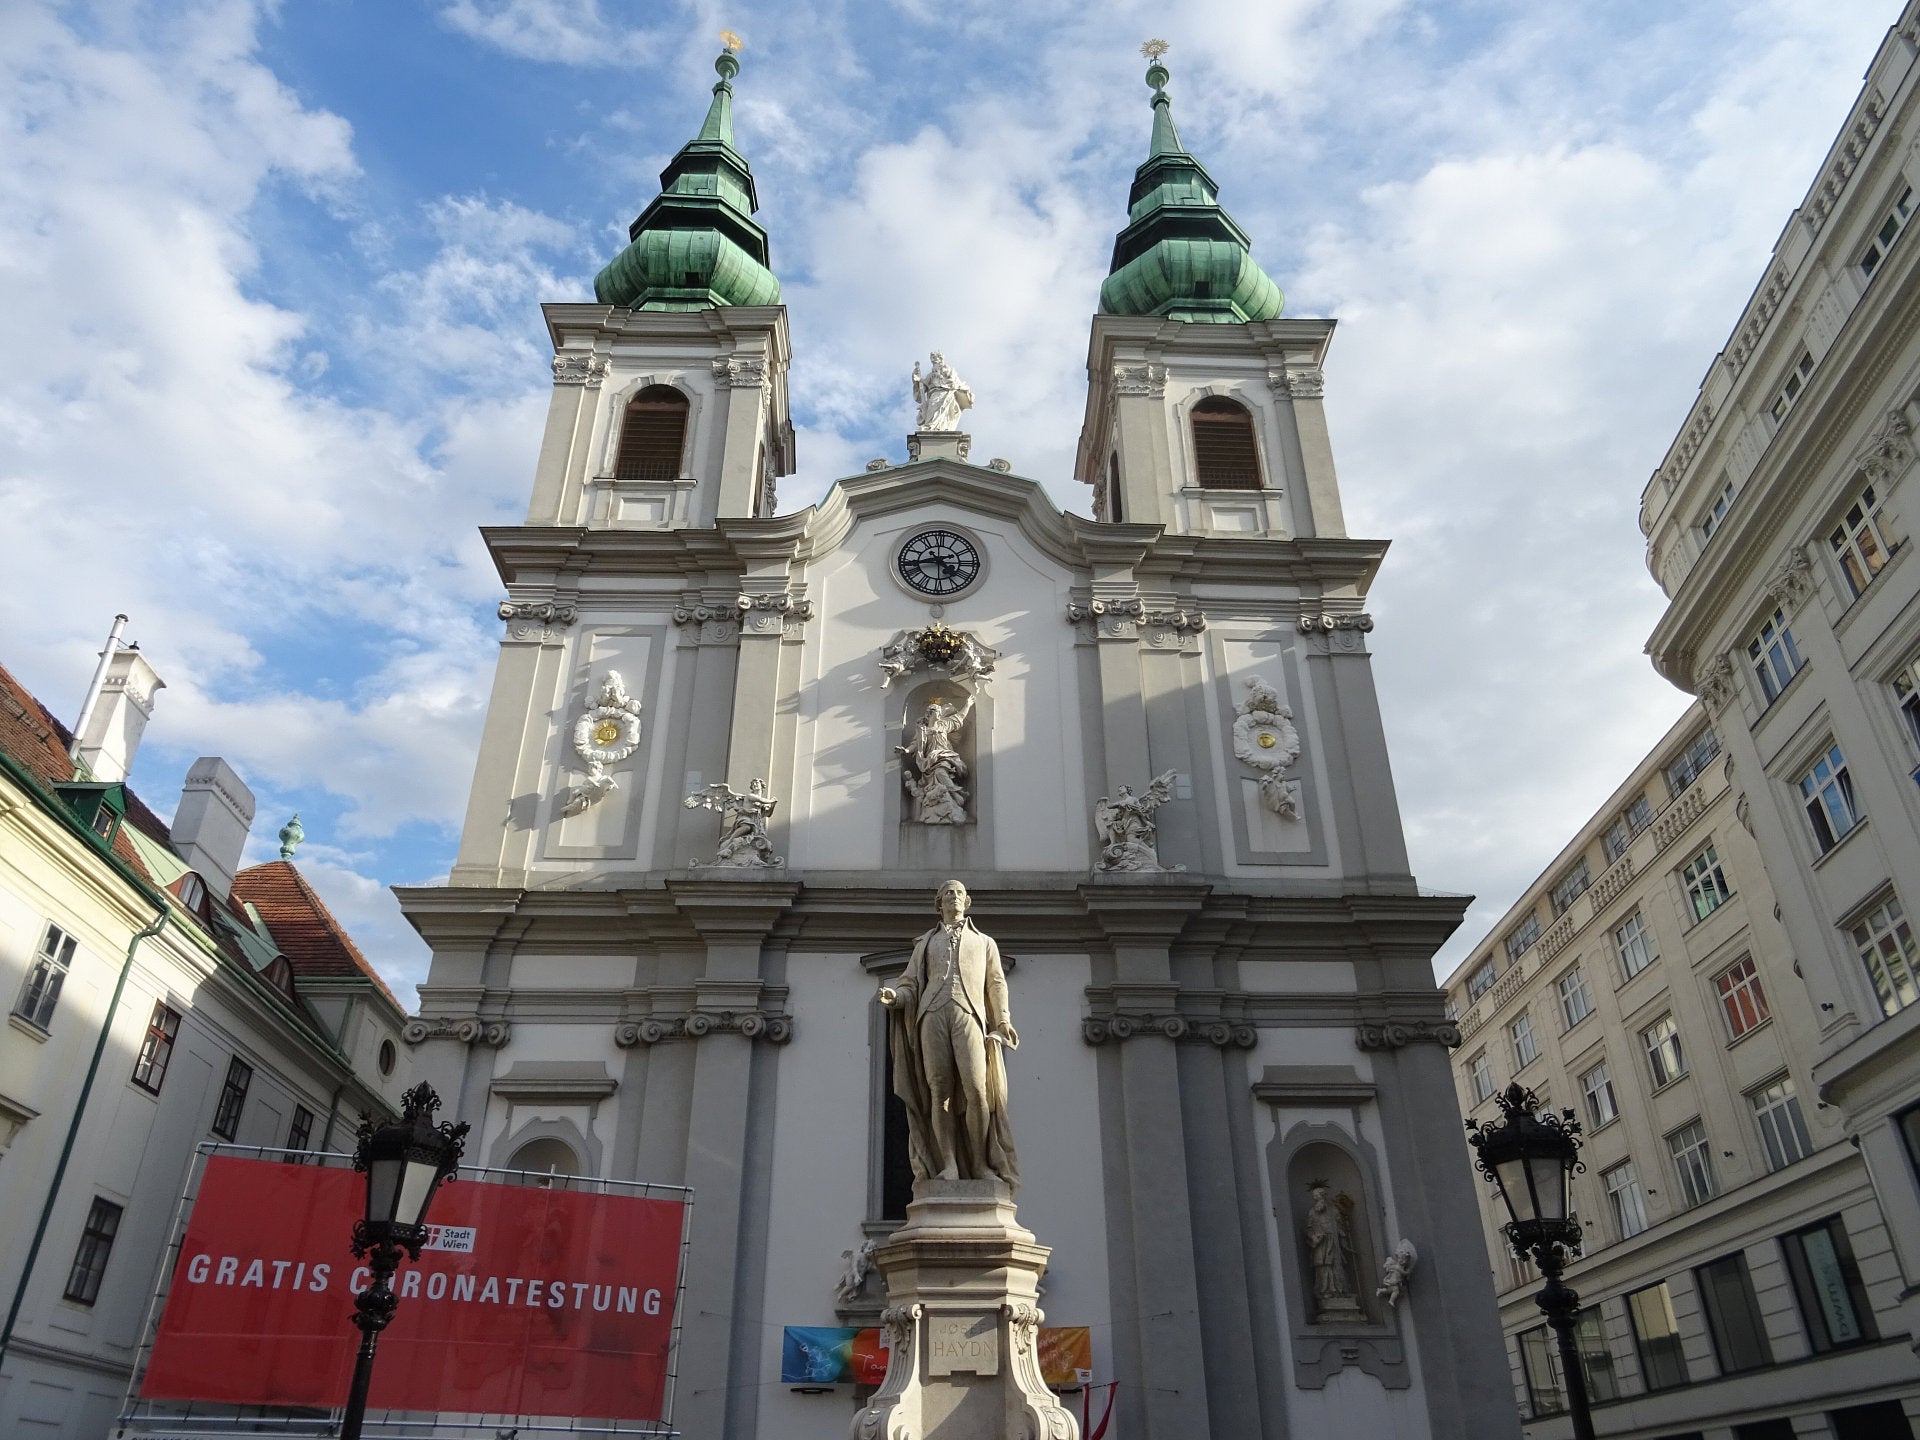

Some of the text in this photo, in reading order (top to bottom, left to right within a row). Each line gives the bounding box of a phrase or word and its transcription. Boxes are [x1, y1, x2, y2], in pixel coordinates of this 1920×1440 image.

[444, 1229, 470, 1239] Stadt
[443, 1239, 468, 1249] Wien
[187, 1254, 661, 1315] GRATIS CRONATESTUNG
[934, 1341, 994, 1357] HAYDN
